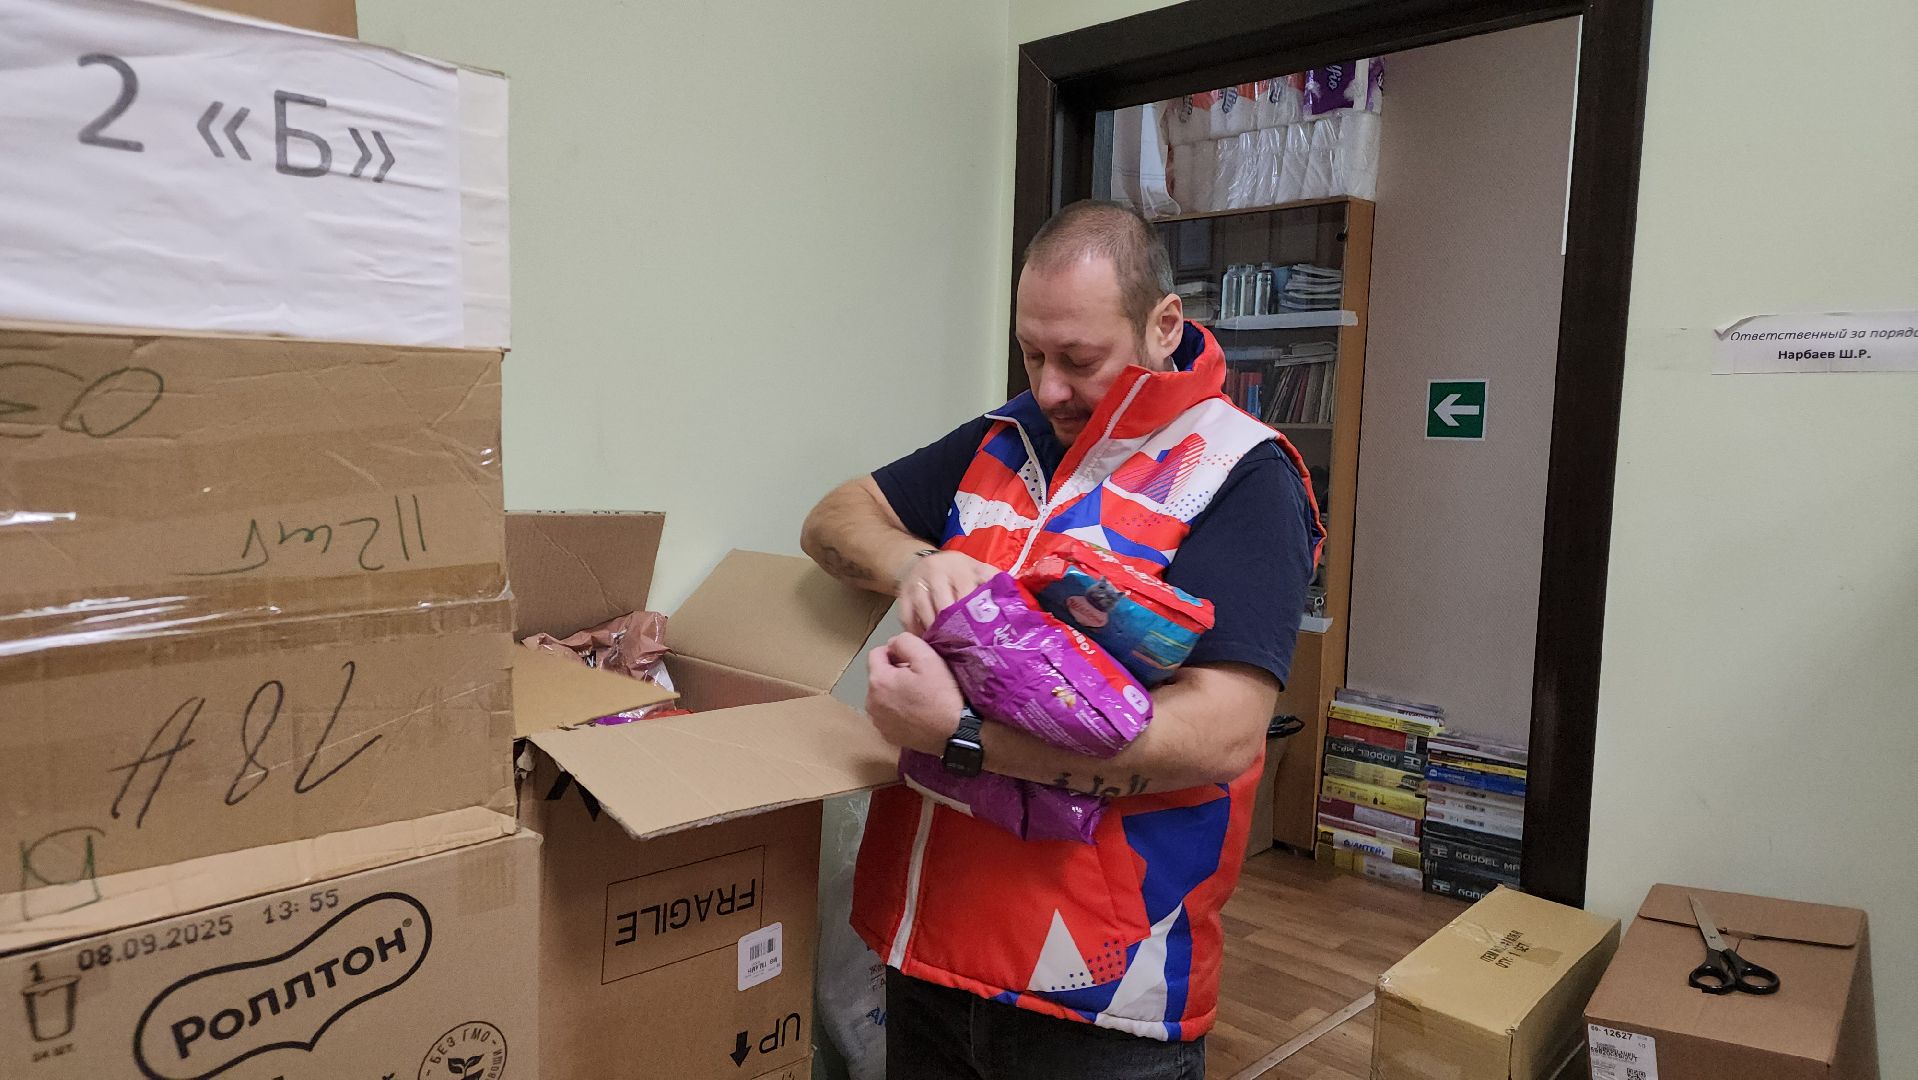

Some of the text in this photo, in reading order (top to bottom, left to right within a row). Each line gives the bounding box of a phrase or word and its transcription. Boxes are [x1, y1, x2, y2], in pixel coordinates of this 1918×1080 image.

[77, 53, 145, 153] 2
[1730, 329, 1848, 341] Ответственный
[1850, 330, 1866, 339] за
[1778, 349, 1872, 362] Нарбаев Ш.Р.
[615, 878, 757, 947] FRAGILE
[78, 914, 234, 971] 08.09.2025
[430, 1027, 491, 1065] БЕЗ ГМО
[759, 1012, 801, 1054] UP
[1603, 1028, 1633, 1041] 12627
